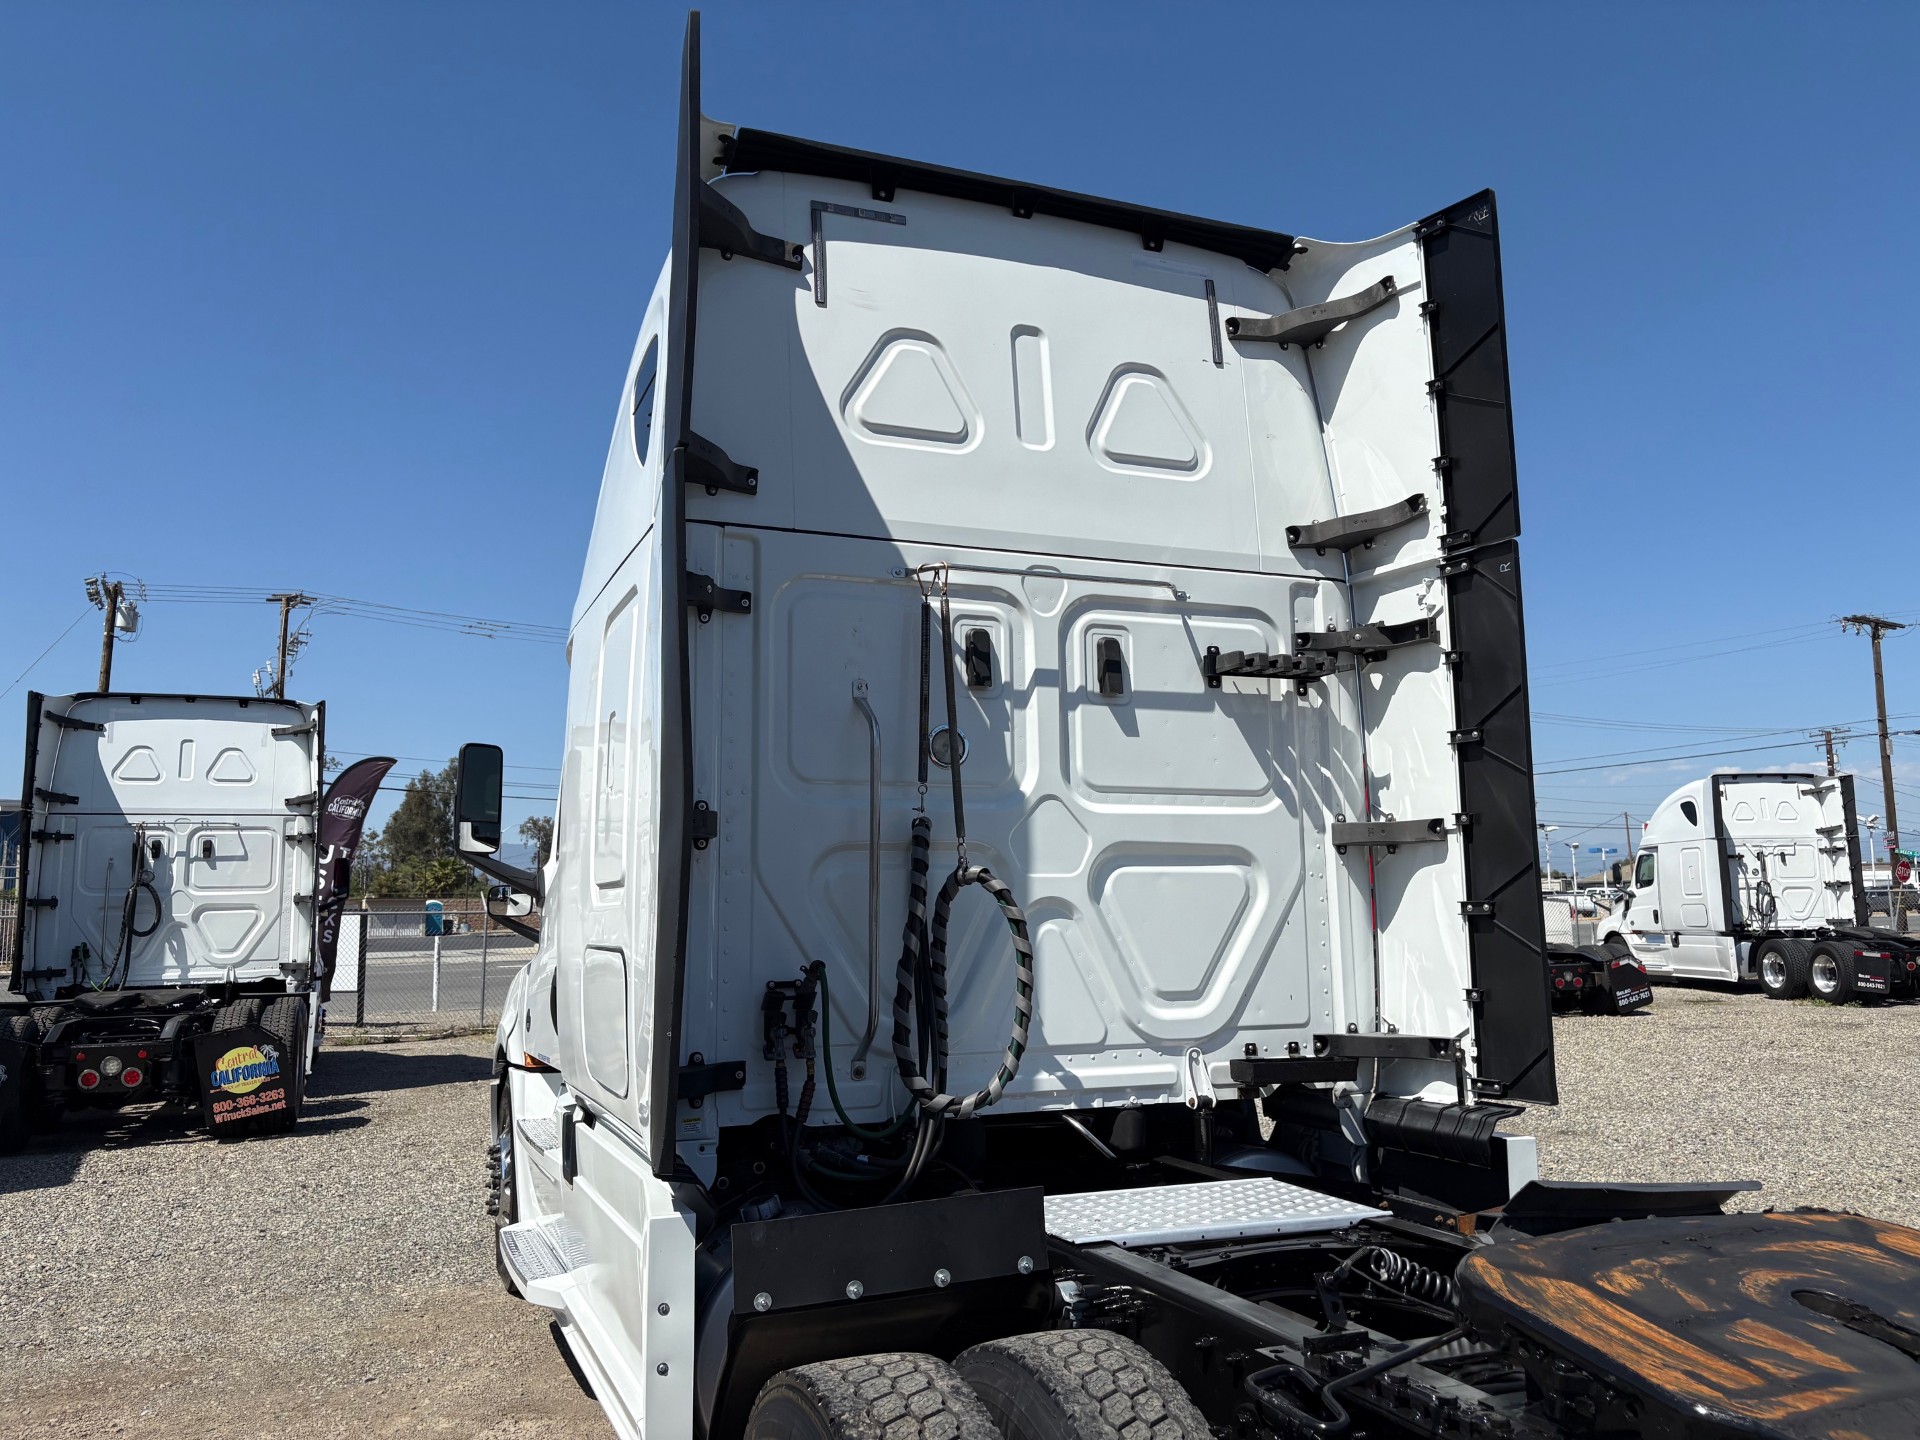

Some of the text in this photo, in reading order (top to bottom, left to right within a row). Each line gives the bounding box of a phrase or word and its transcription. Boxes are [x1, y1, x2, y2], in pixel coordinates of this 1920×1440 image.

[1500, 562, 1511, 573] R
[328, 803, 362, 818] CALIFORNIA
[1897, 866, 1911, 877] STOP
[216, 1045, 259, 1071] Central
[211, 1060, 280, 1087] CALIFORNIA
